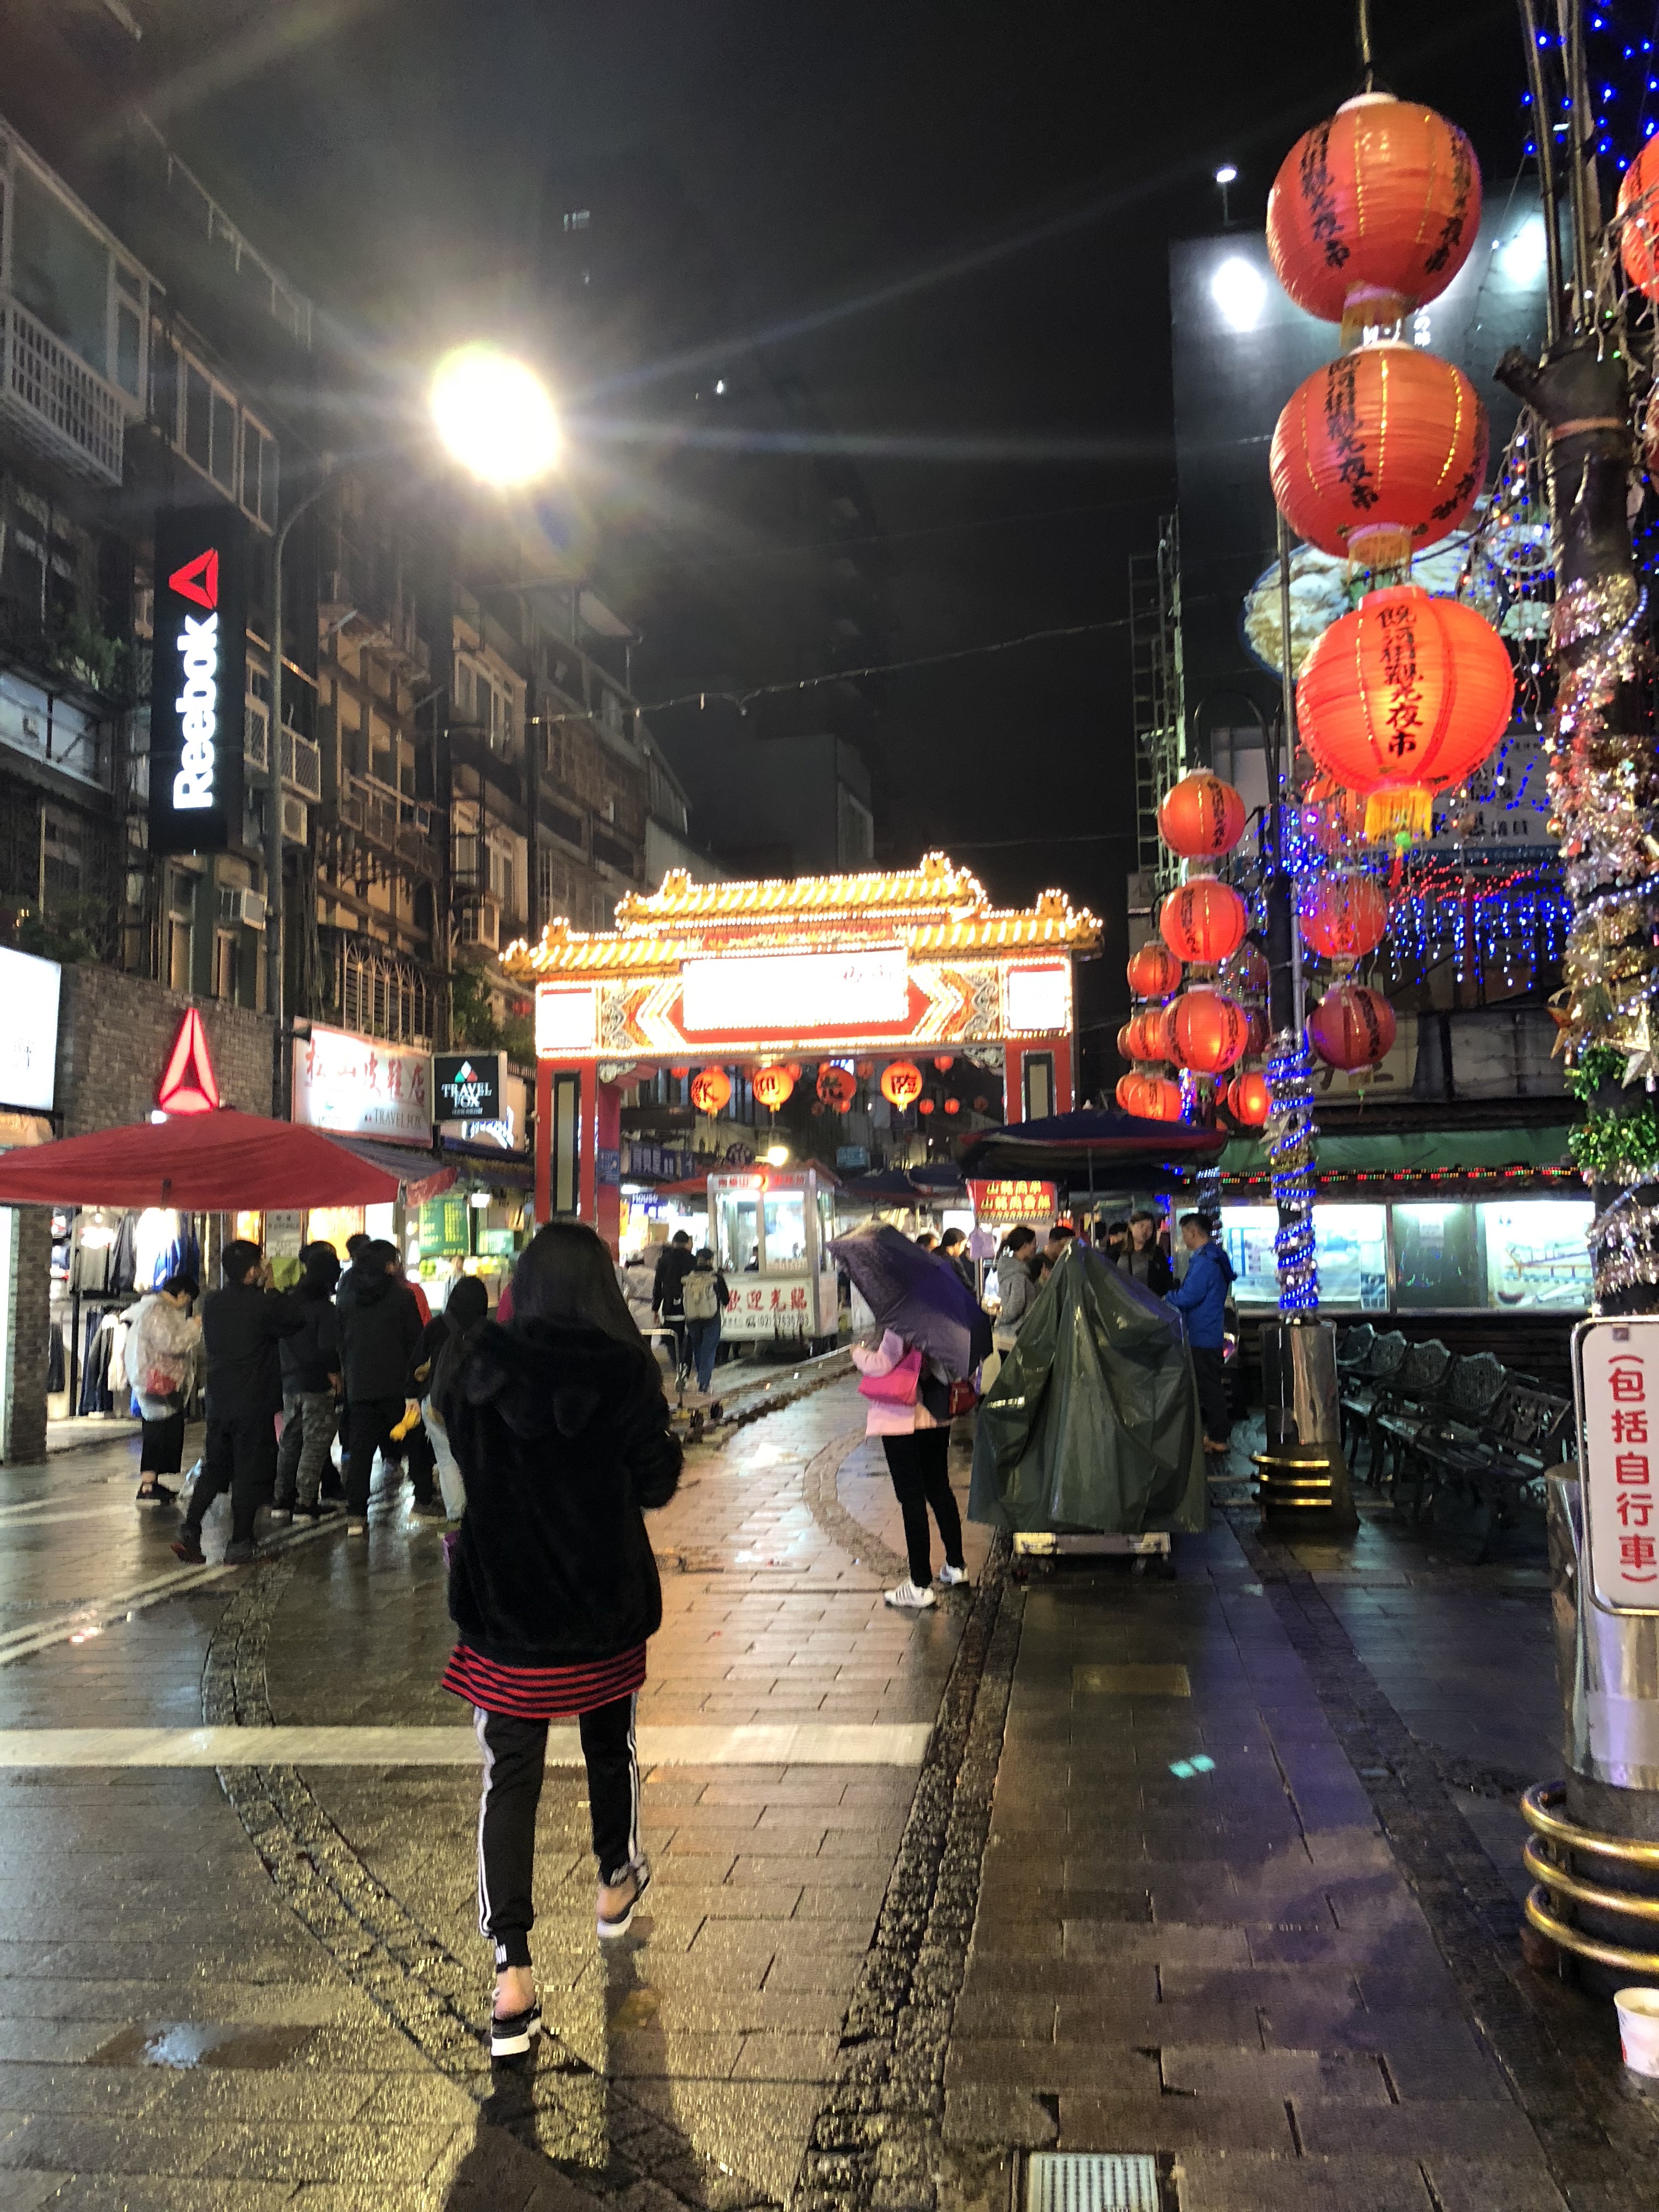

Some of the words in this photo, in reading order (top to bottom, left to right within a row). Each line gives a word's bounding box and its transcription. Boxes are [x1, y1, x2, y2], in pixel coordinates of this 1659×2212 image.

[173, 611, 219, 810] Reebok
[374, 1107, 405, 1128] TRAVEL
[442, 1082, 492, 1098] TRAVEL
[1607, 1353, 1657, 1583] (包括自行車)
